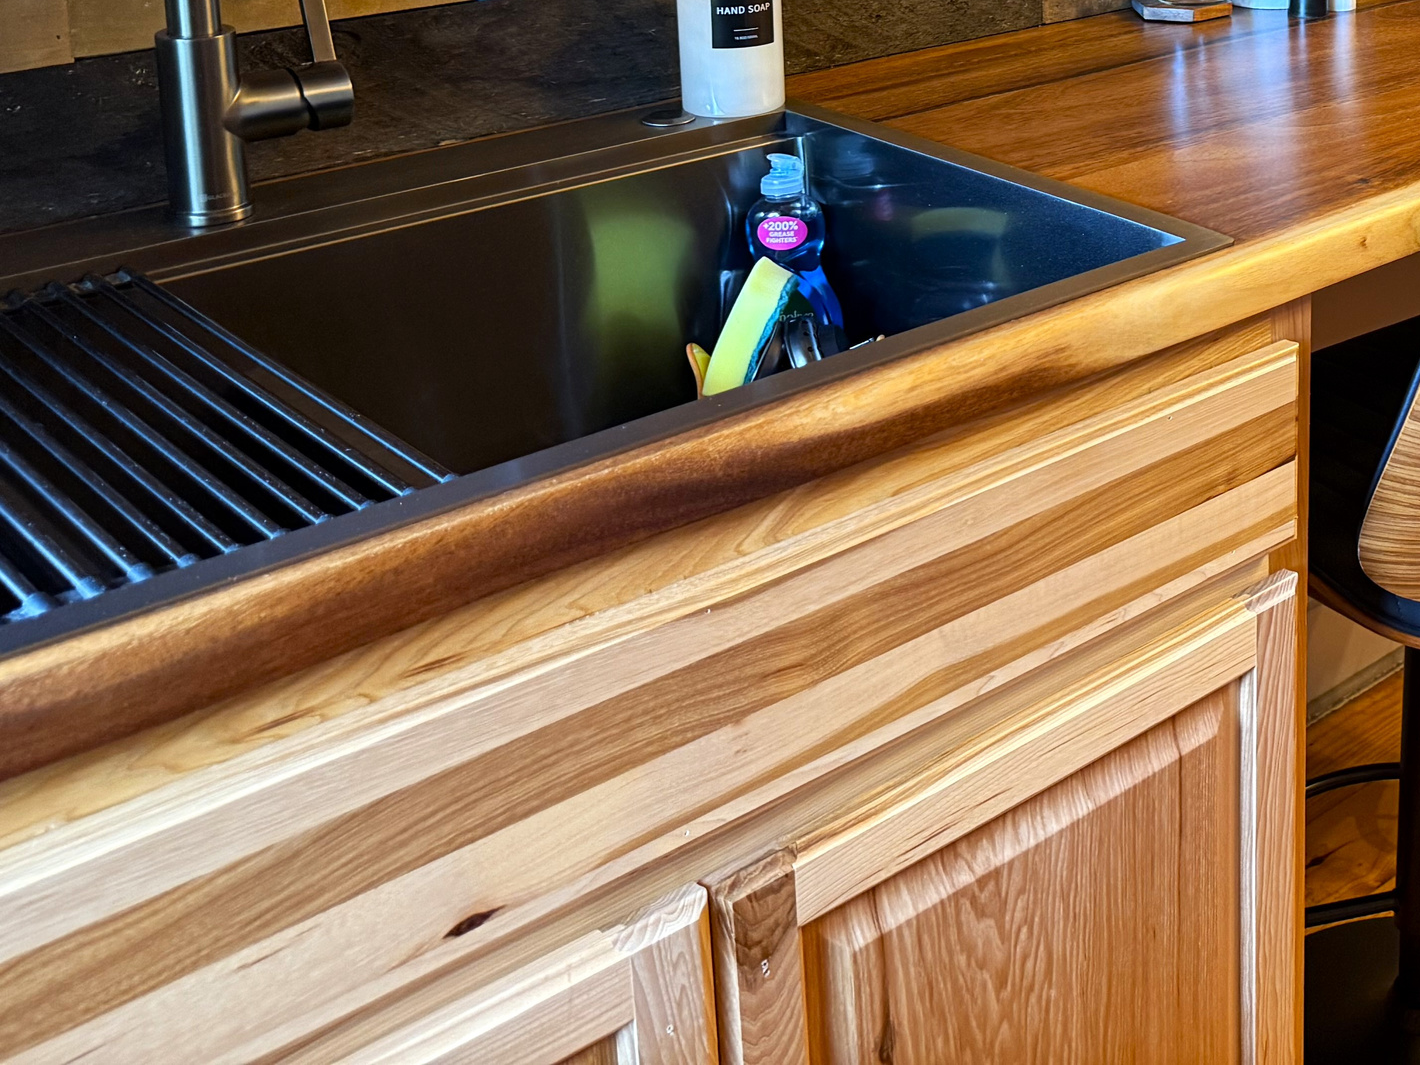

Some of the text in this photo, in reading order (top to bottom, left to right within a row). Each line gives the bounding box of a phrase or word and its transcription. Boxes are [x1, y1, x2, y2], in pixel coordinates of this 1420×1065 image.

[716, 2, 770, 15] HAND SOAP
[763, 220, 799, 231] +200%
